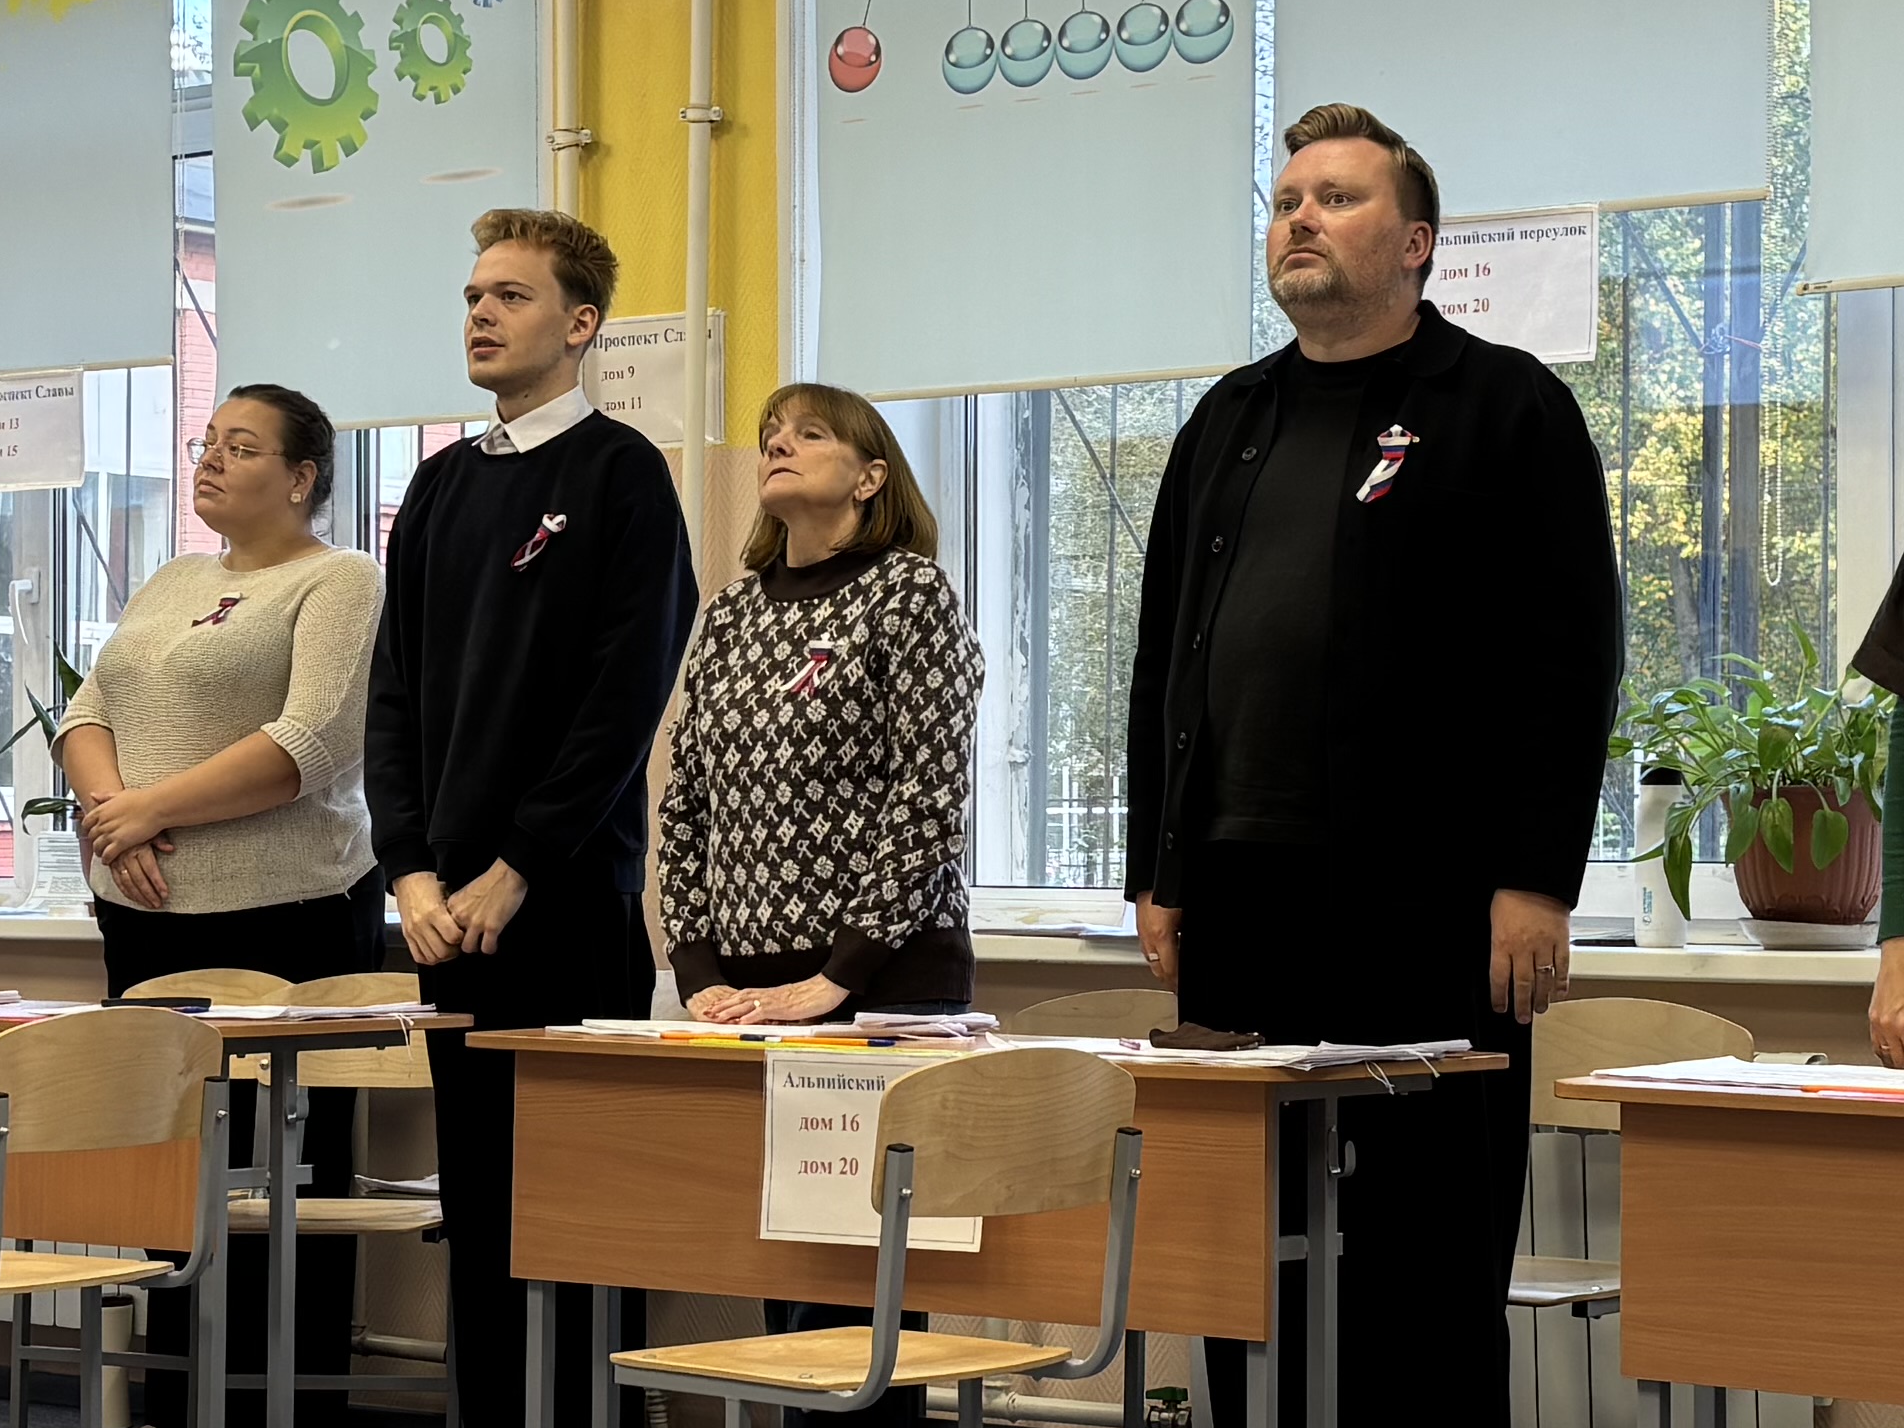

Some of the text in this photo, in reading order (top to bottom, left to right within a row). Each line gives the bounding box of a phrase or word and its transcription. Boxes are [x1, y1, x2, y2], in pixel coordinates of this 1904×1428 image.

[1435, 225, 1587, 247] льпийский переулок
[1439, 262, 1491, 281] дом 16
[1472, 298, 1490, 313] 20
[601, 365, 635, 382] дом 9
[36, 385, 74, 399] Славы
[603, 396, 642, 413] дом 11
[9, 418, 20, 429] 13
[7, 445, 18, 456] 15
[783, 1072, 886, 1091] Альпийский
[798, 1113, 860, 1132] дом 16
[798, 1157, 859, 1176] дом 20
